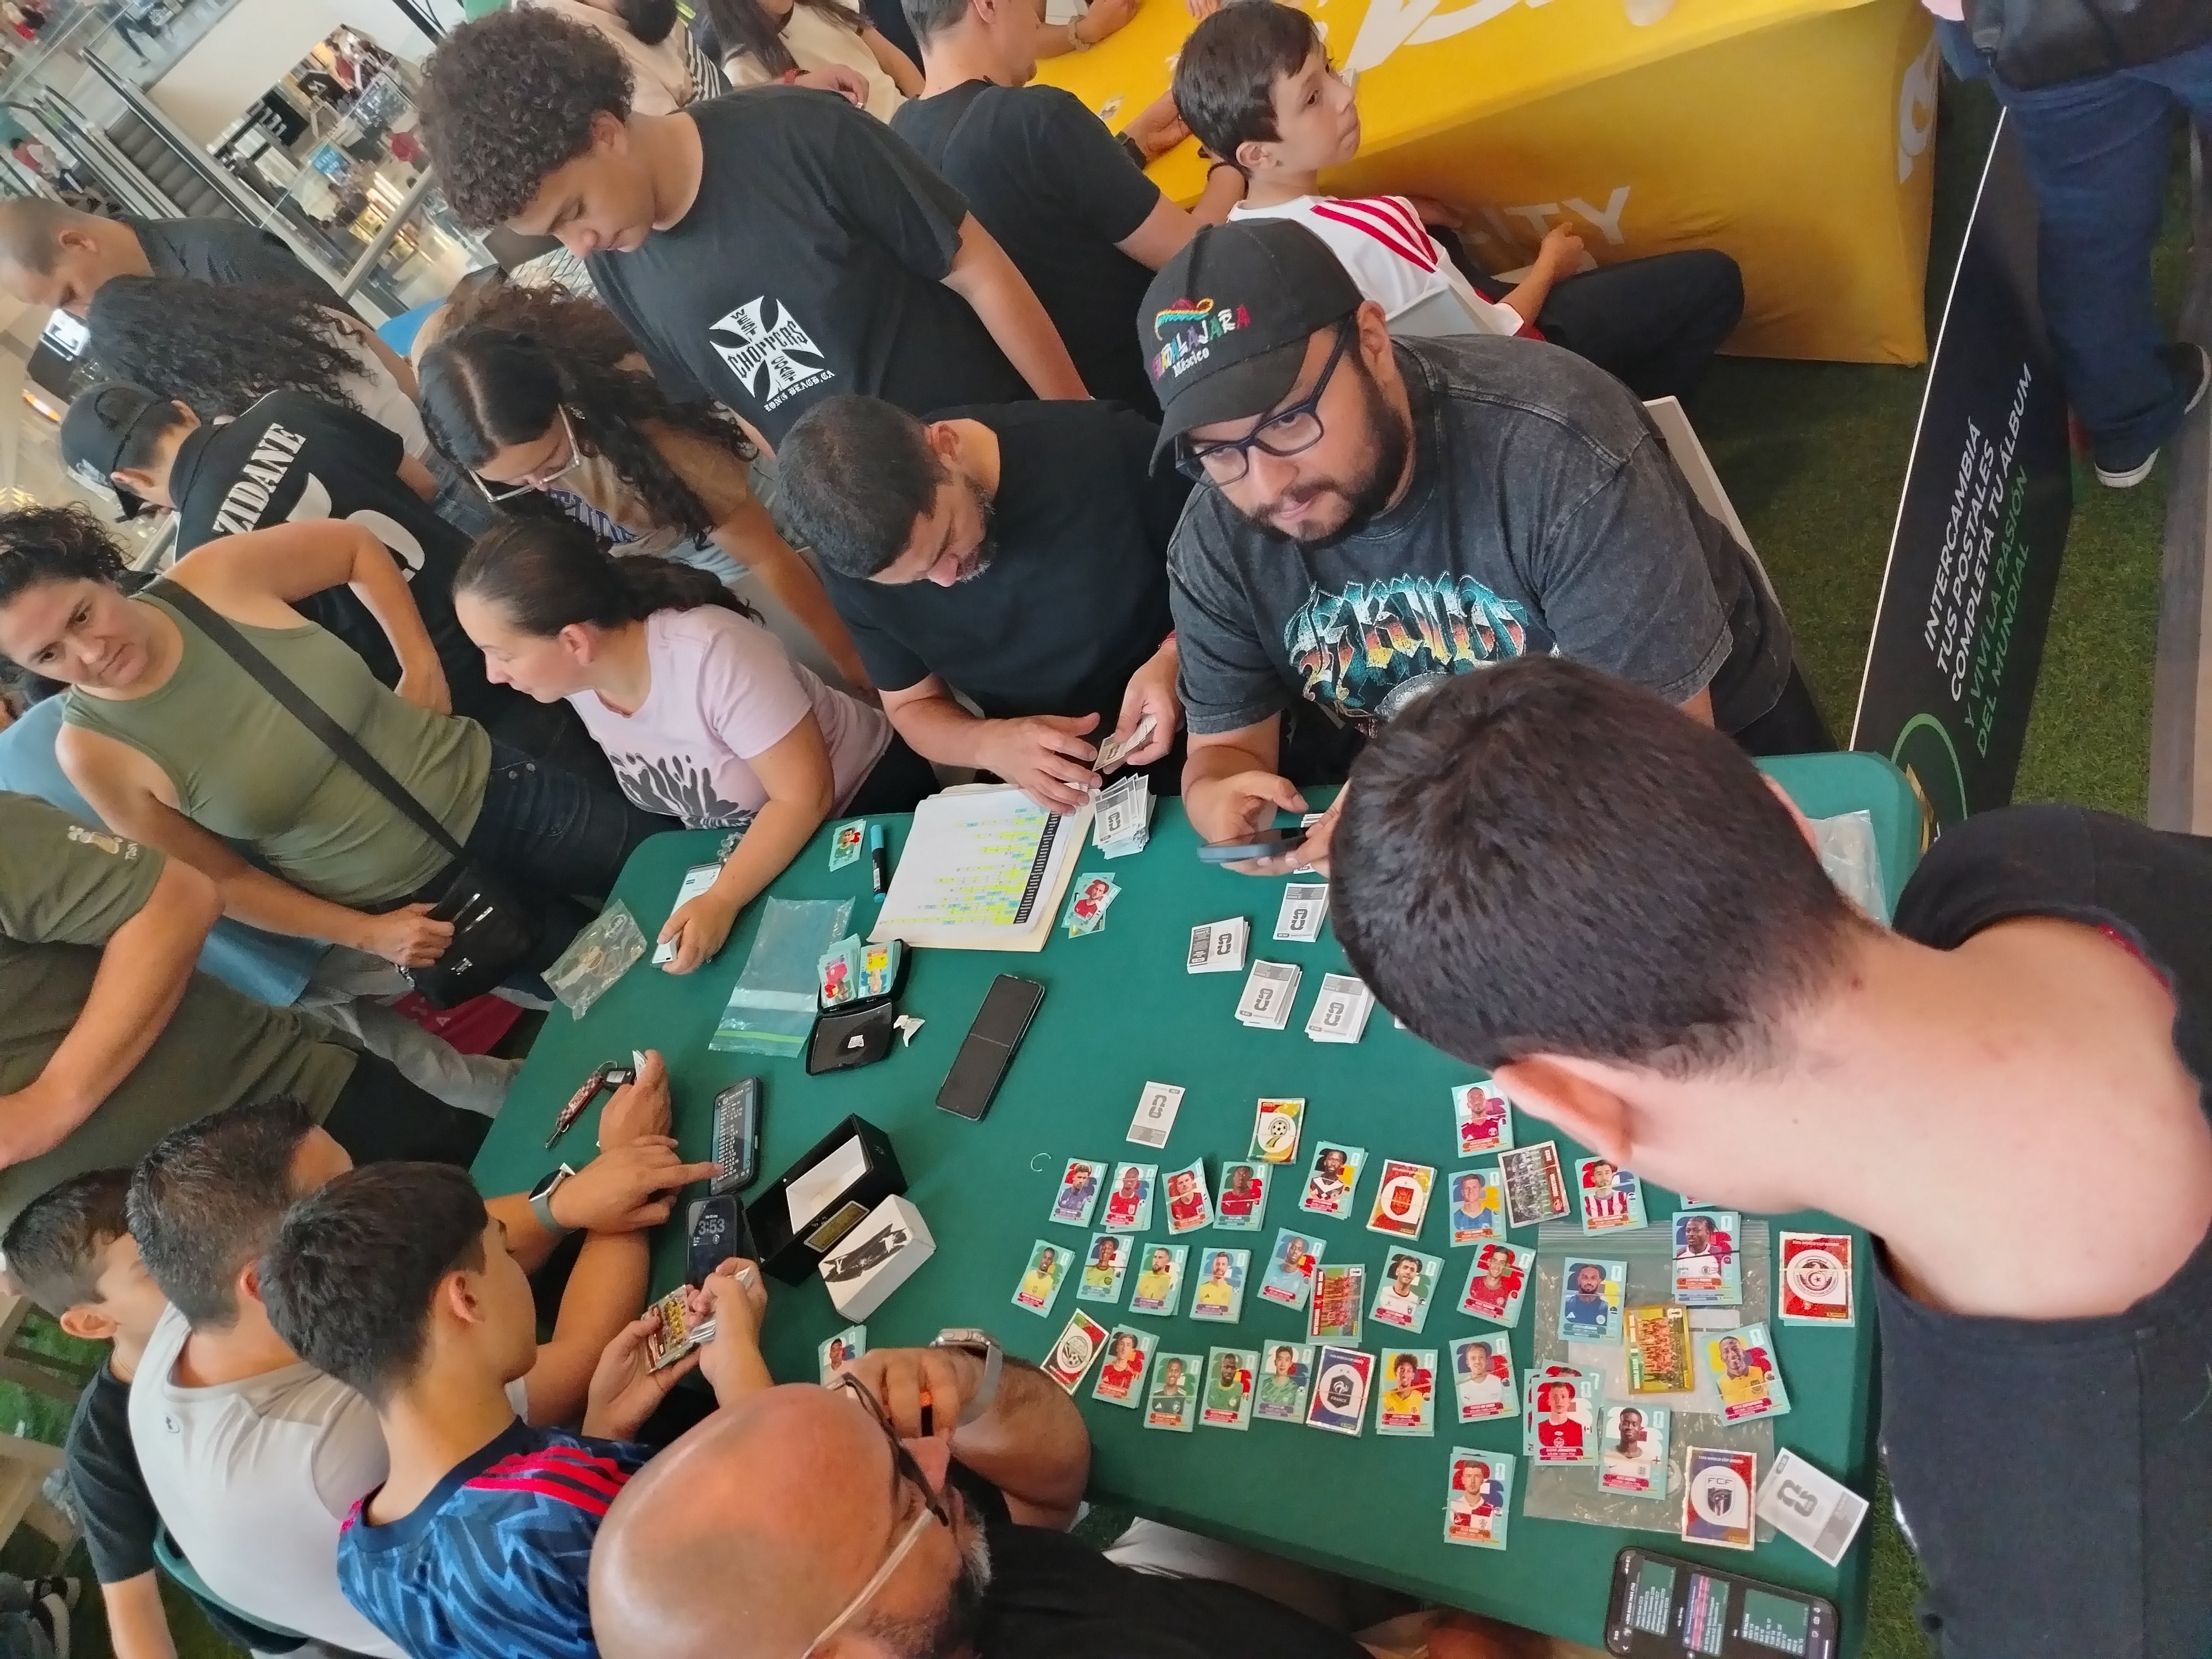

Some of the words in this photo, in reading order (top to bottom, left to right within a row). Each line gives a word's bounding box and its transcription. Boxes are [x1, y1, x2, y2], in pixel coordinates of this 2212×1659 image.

[727, 320, 808, 378] CHOPPERS
[730, 309, 758, 342] WEST
[771, 356, 796, 392] COAST
[212, 422, 306, 535] ZIDANE
[1924, 416, 1980, 651] INTERCAMBIÁ
[1951, 519, 1994, 702] COMPLETÁ
[1989, 474, 2004, 519] TU
[2000, 362, 2032, 478] ÁLBUM
[1937, 606, 1958, 674] TUS
[1953, 439, 1993, 607] POSTALES
[1964, 702, 1975, 728] Y
[1970, 625, 1991, 698] VIVÍ
[1986, 591, 2001, 633] LA
[1995, 465, 2028, 586] PASIÓN
[1977, 695, 1997, 759] DEL
[1992, 542, 2029, 686] MUNDIAL
[699, 1218, 726, 1238] 3:53
[1708, 1477, 1733, 1485] FCF
